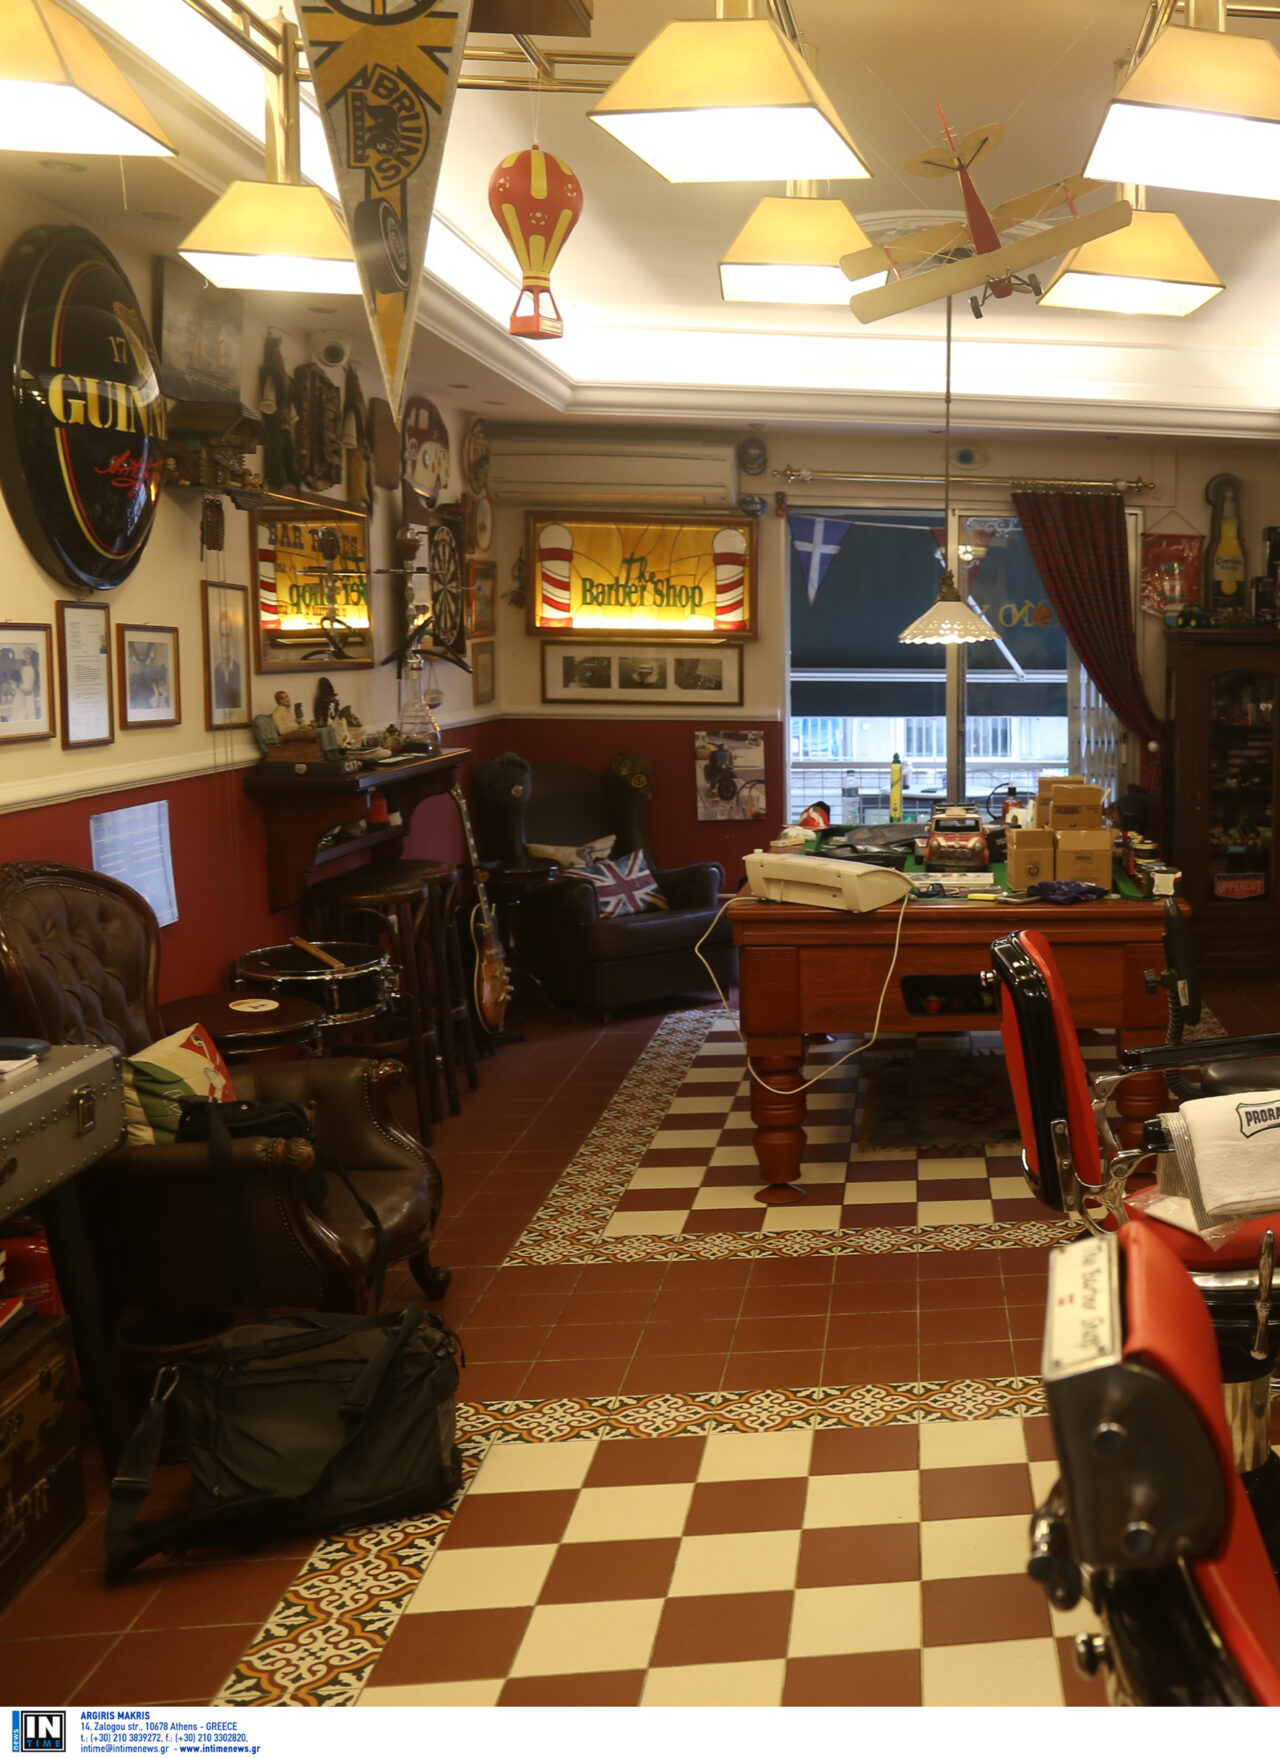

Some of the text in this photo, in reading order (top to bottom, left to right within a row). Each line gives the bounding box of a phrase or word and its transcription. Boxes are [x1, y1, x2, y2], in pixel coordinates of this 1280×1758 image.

[371, 72, 423, 182] BRUINS
[622, 551, 656, 585] The
[581, 576, 704, 615] Barber Shop
